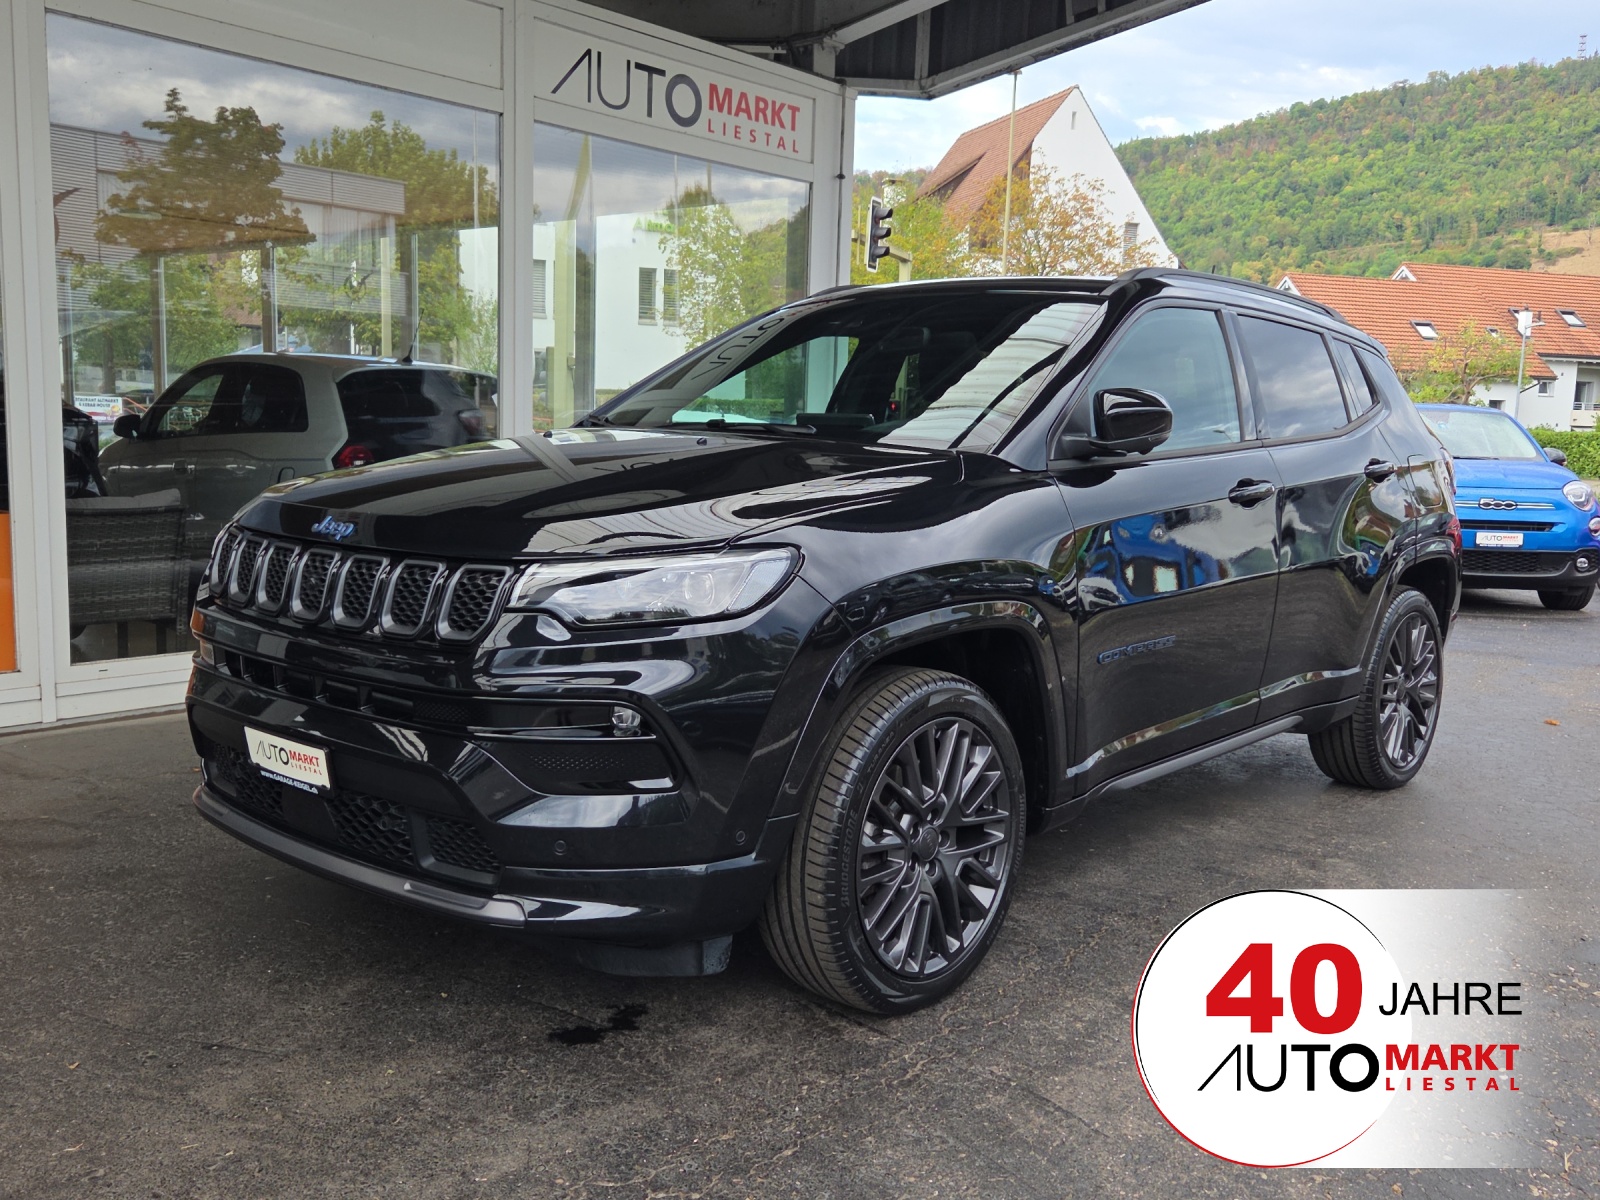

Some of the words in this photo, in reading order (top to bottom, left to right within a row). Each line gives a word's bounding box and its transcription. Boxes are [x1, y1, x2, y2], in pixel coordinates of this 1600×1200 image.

[709, 83, 800, 132] MARKT
[707, 118, 799, 154] LIESTAL
[1478, 497, 1518, 510] 500
[311, 515, 354, 541] Jeep
[1096, 635, 1176, 664] COMPASS
[289, 750, 320, 767] MARKT
[291, 763, 322, 775] LIESTAL
[840, 809, 857, 908] BRIDGESTONE
